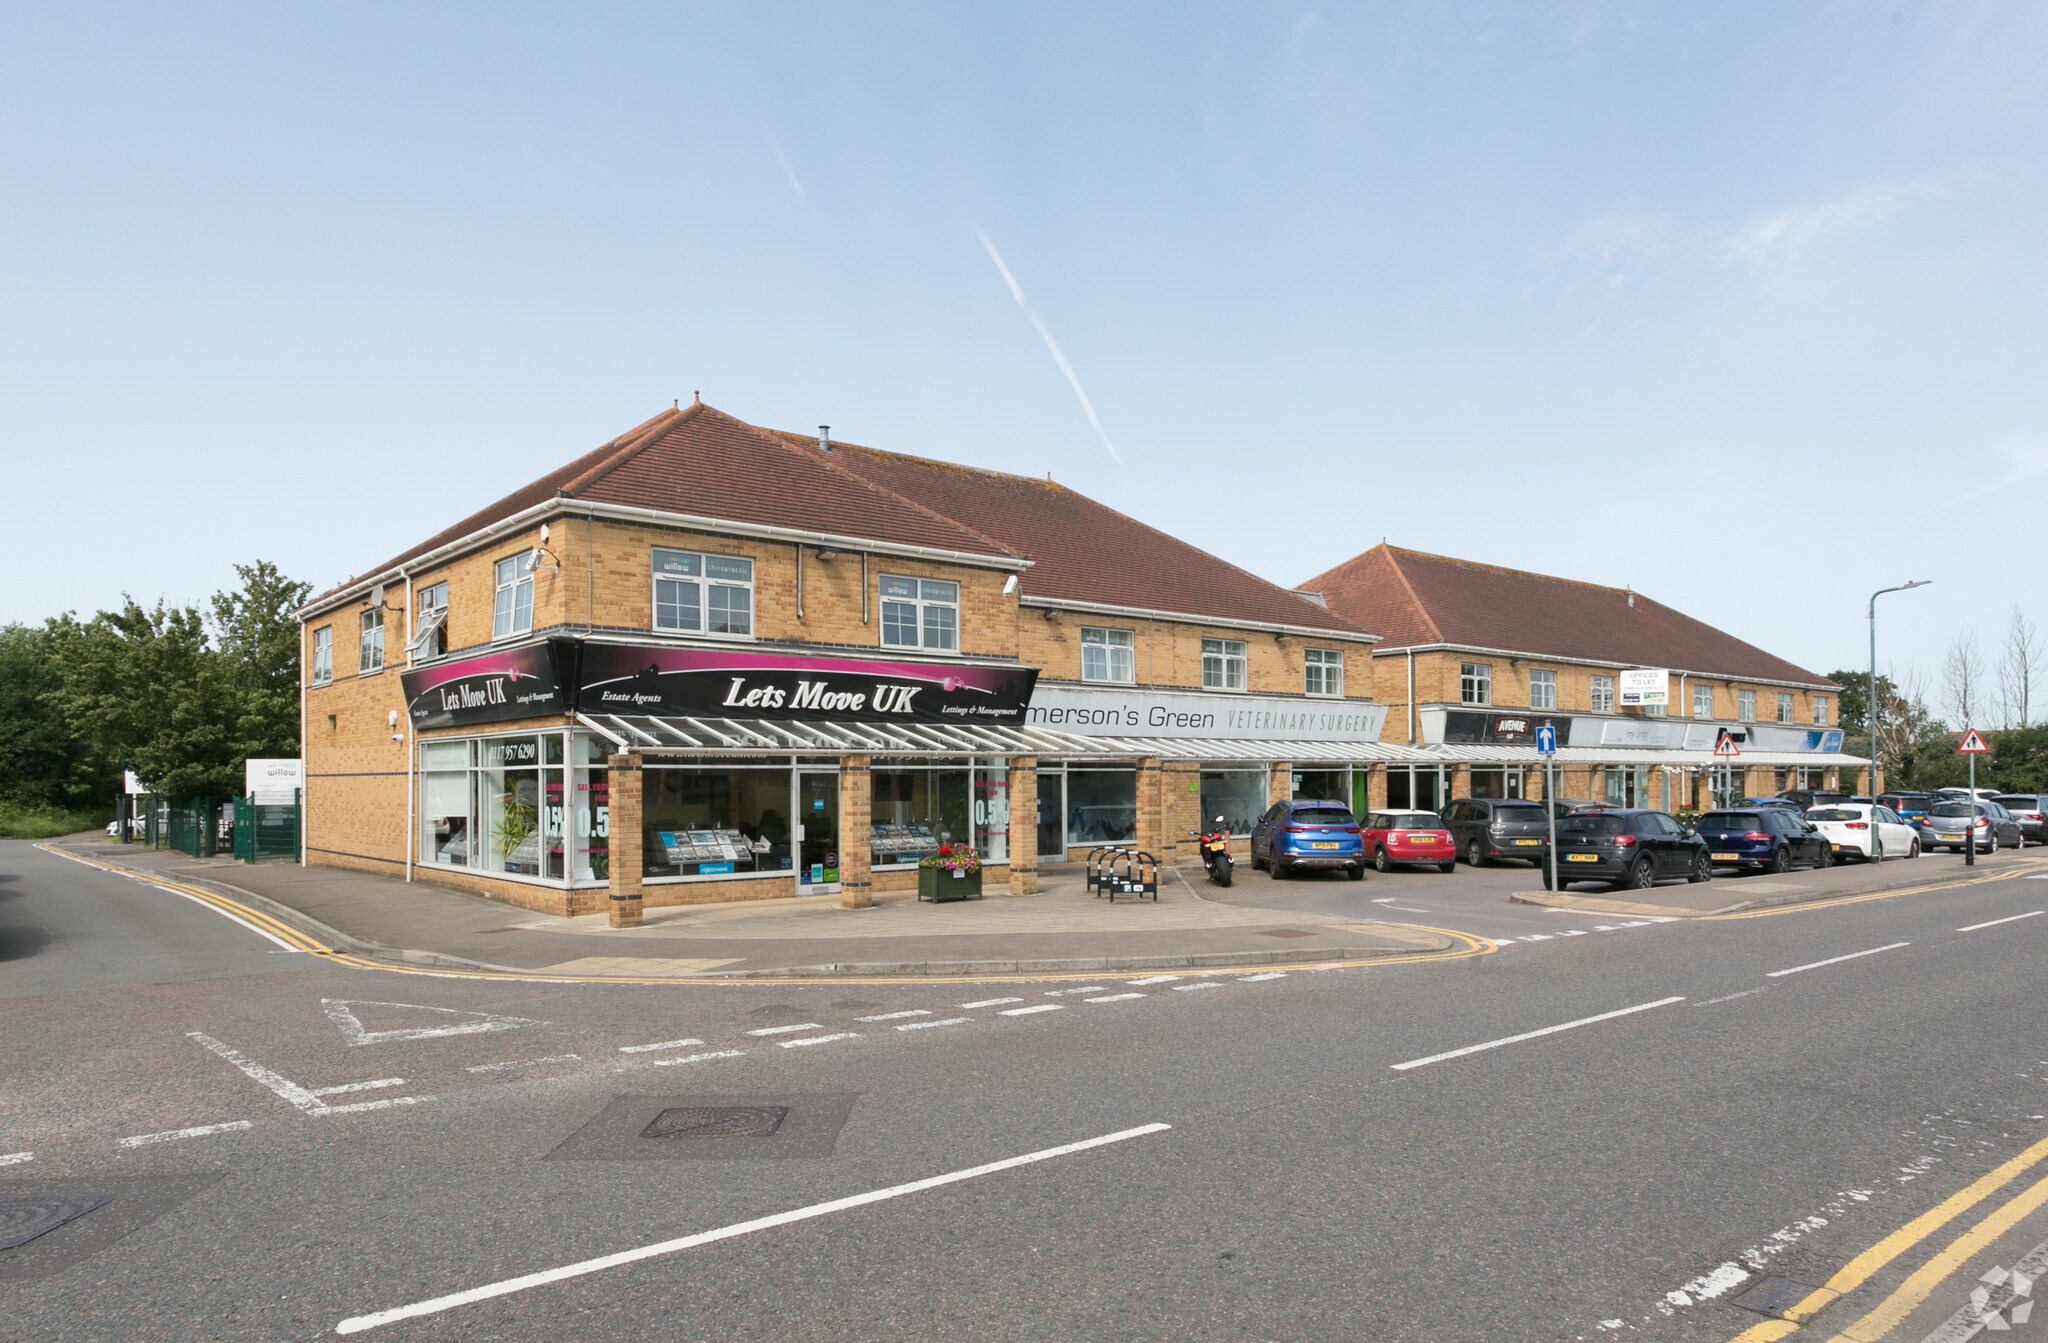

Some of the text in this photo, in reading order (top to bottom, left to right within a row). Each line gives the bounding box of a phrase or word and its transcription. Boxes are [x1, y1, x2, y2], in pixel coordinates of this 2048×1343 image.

[664, 562, 689, 572] willow
[707, 564, 748, 574] chiropractic
[440, 678, 507, 711] Lets Move UK
[601, 691, 662, 704] Estate Agents
[723, 677, 922, 713] Lets Move UK
[942, 705, 1018, 717] Lettings & Management
[1148, 706, 1215, 728] Green
[1228, 710, 1376, 732] VETERINARY SURGERY
[1498, 720, 1526, 732] AVENUE
[490, 744, 535, 760] 0117 957 6290
